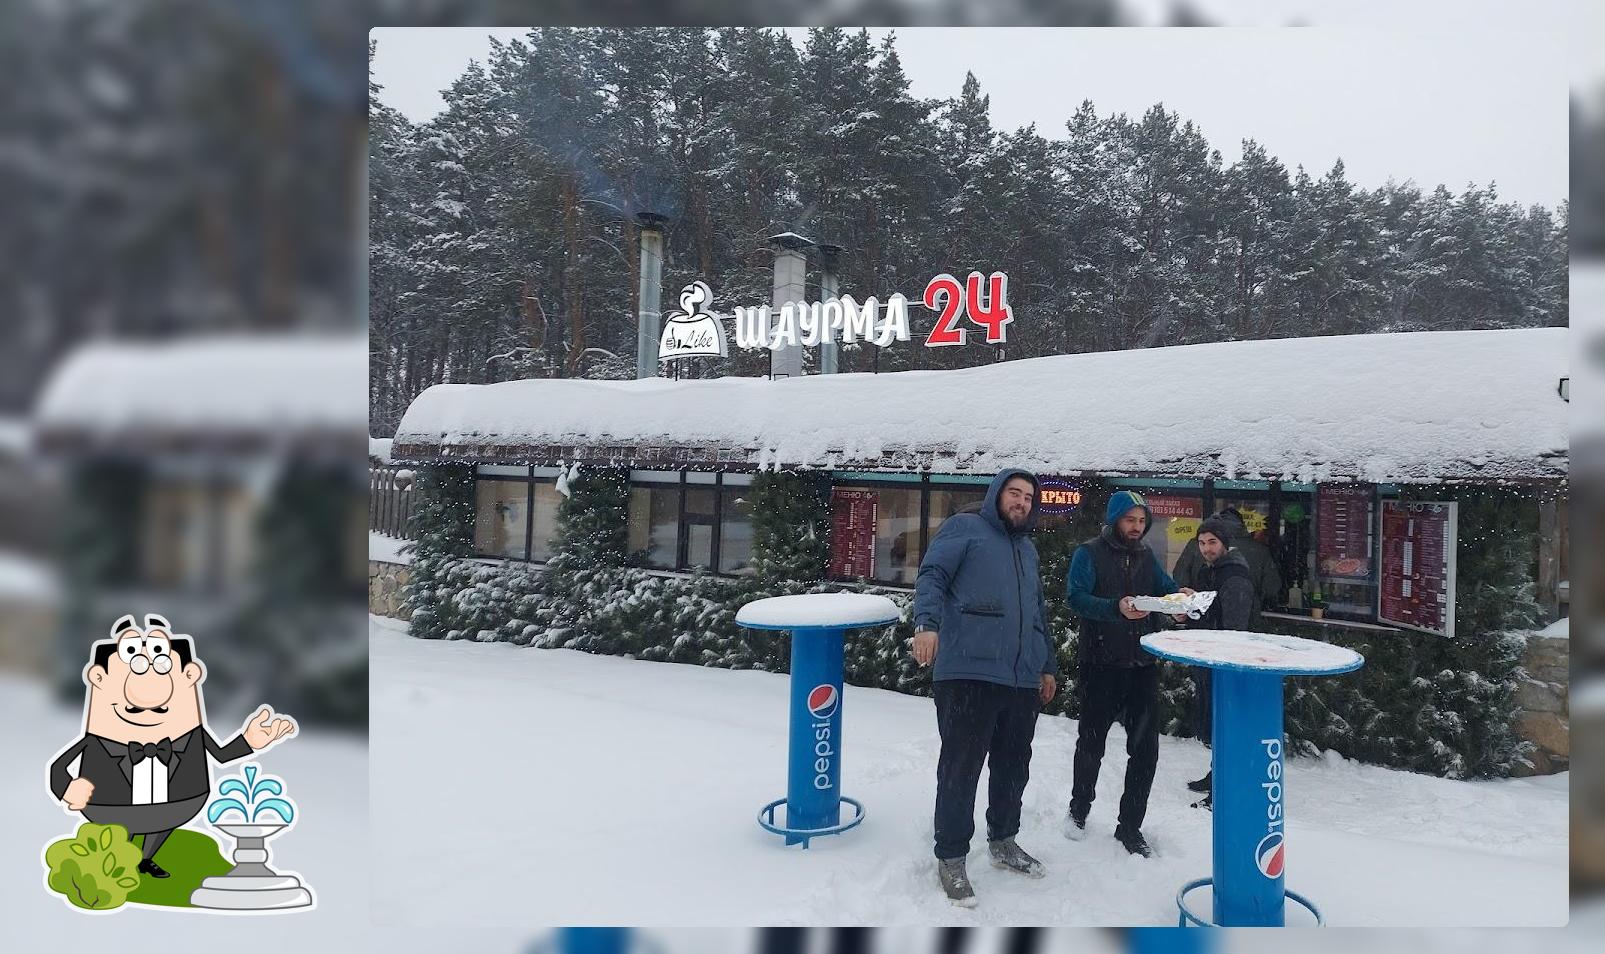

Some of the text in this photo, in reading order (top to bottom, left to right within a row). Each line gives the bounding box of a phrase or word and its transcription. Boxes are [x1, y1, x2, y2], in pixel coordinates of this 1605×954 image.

[681, 329, 713, 349] Like
[735, 271, 1014, 350] ШАУРМА 24
[1040, 490, 1080, 505] КРЫТО
[812, 719, 834, 790] pepsi
[1261, 738, 1284, 828] pepsi
